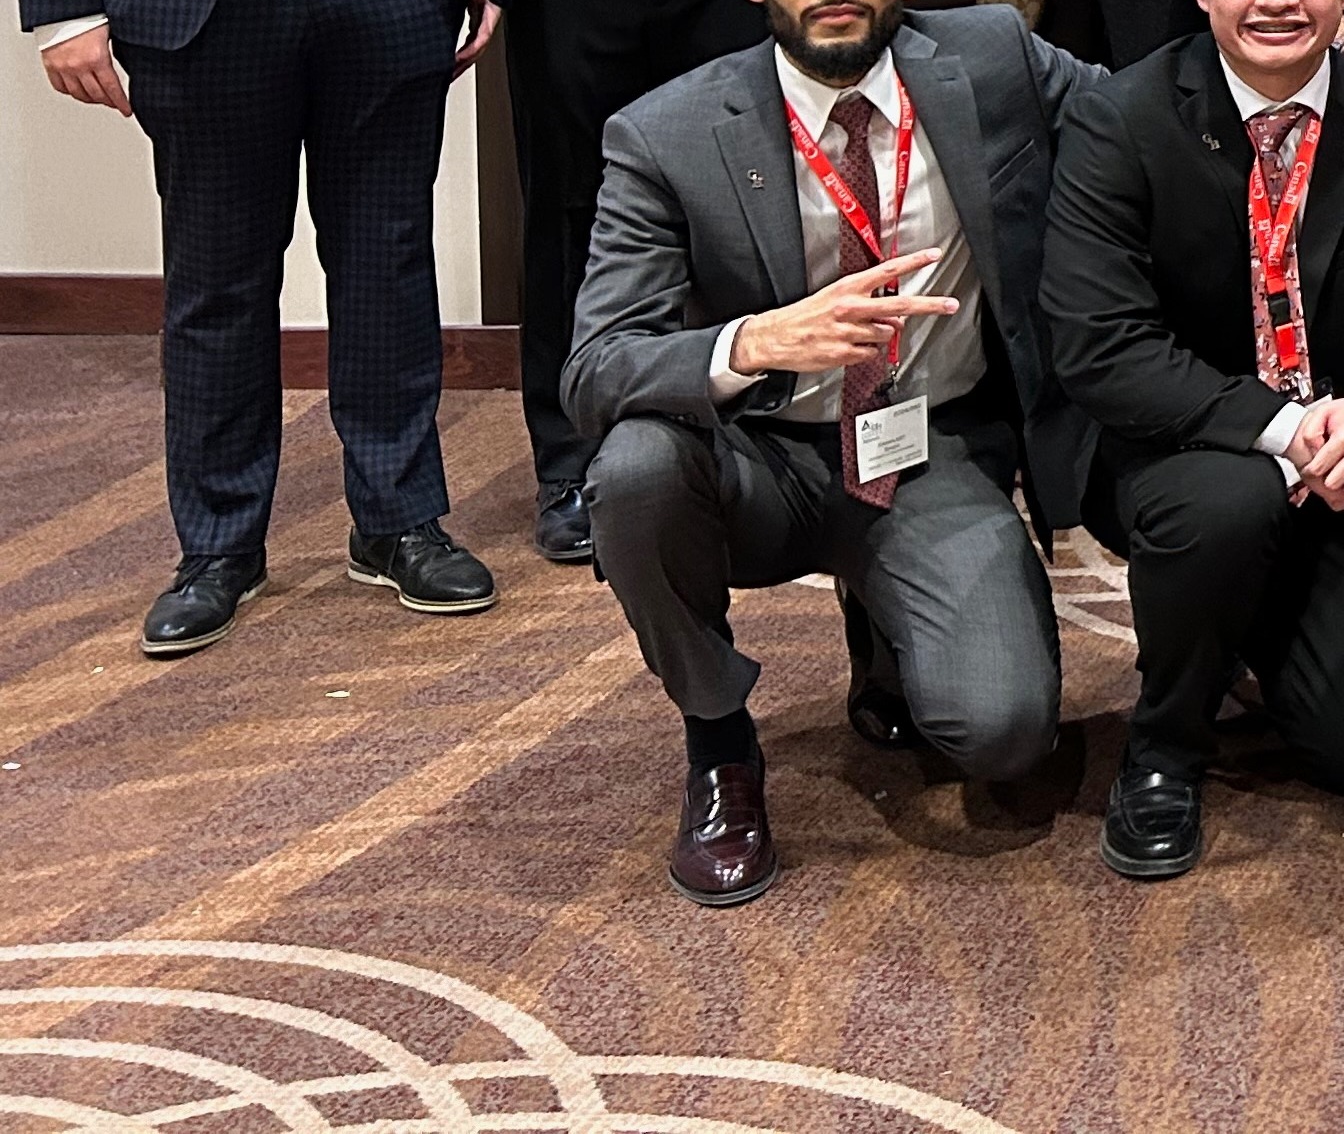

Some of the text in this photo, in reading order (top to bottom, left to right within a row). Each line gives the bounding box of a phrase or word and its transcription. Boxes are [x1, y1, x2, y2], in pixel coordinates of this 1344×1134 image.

[900, 87, 913, 130] anada
[788, 118, 819, 160] Canada
[823, 171, 857, 213] Canada
[1284, 161, 1307, 206] Canada
[1268, 224, 1287, 266] Canada
